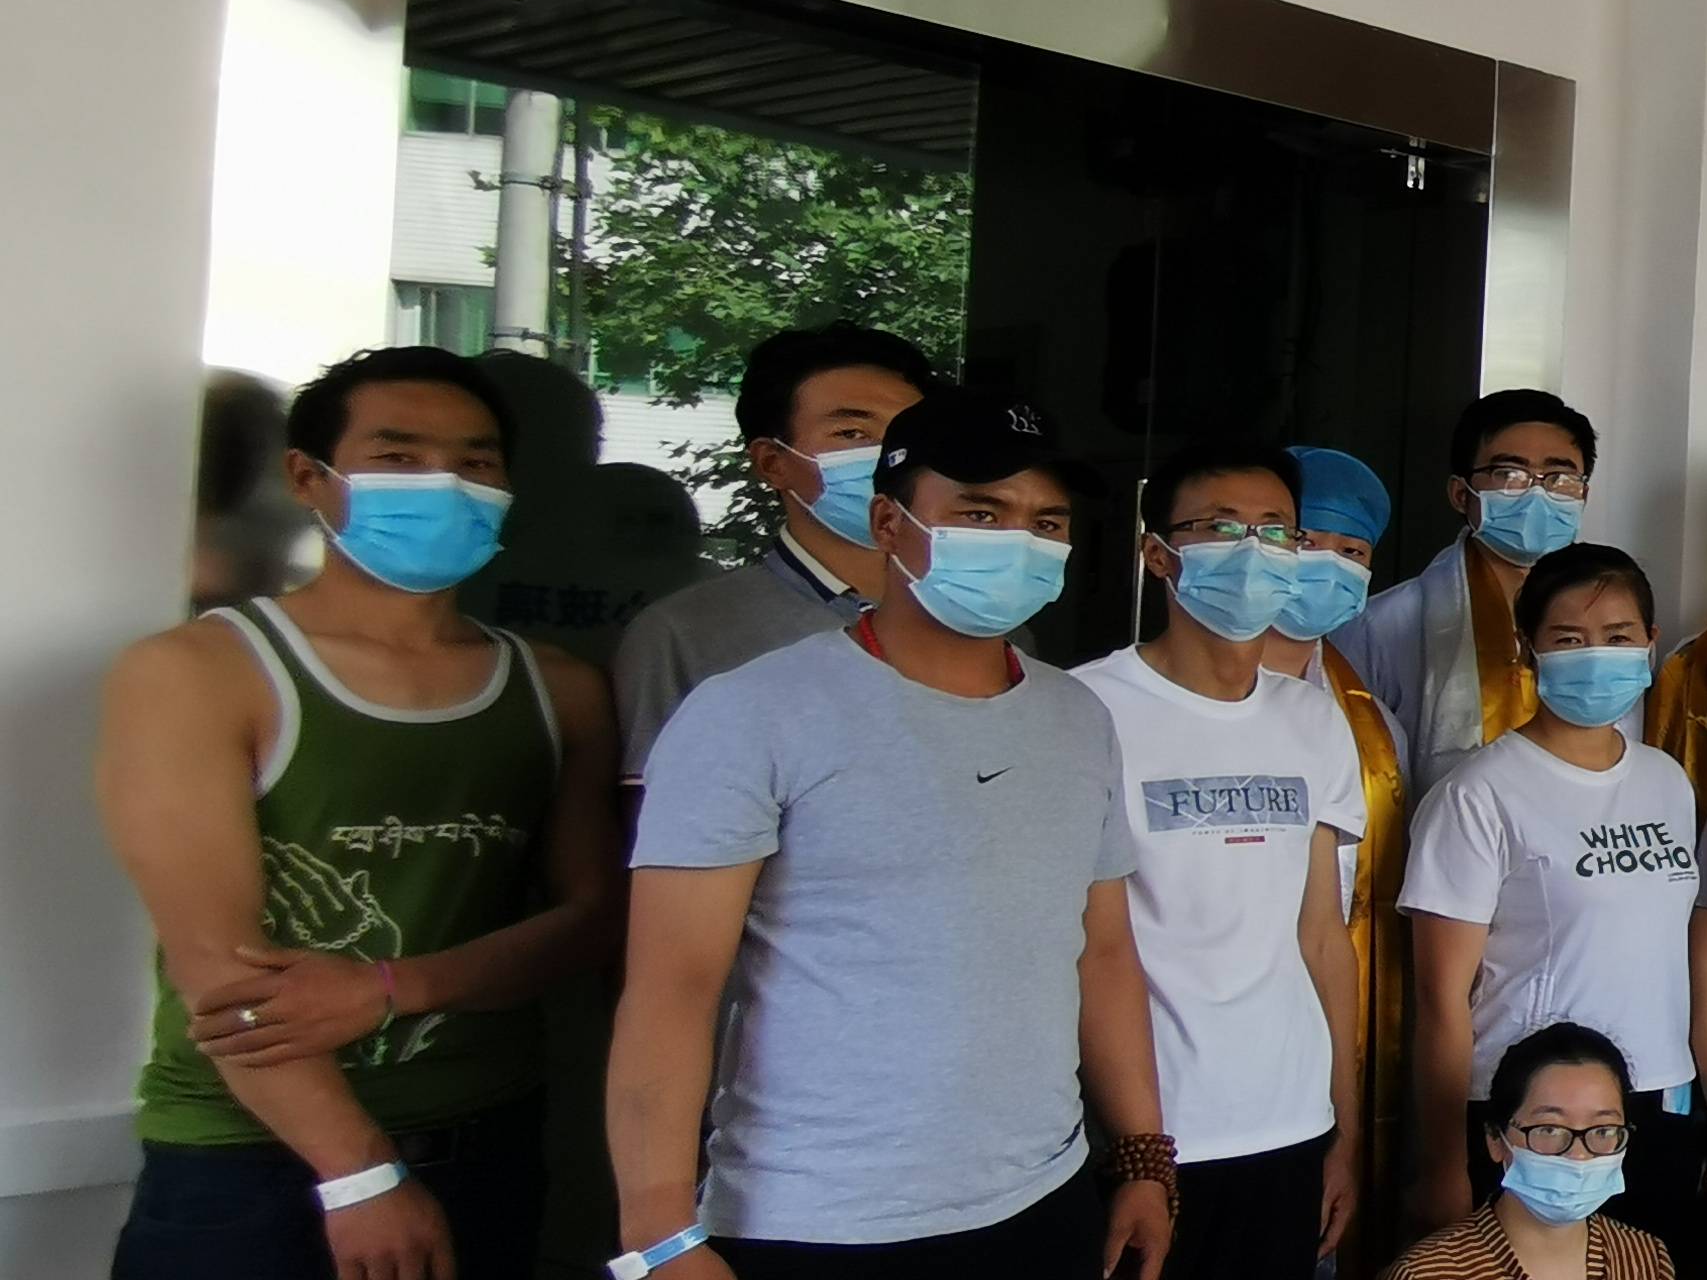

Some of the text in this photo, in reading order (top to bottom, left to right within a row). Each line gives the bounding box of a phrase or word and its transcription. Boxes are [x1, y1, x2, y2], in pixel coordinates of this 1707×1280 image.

[1167, 786, 1299, 817] FUTURE
[1579, 822, 1674, 849] WHITE
[1575, 846, 1692, 877] CHOCHO
